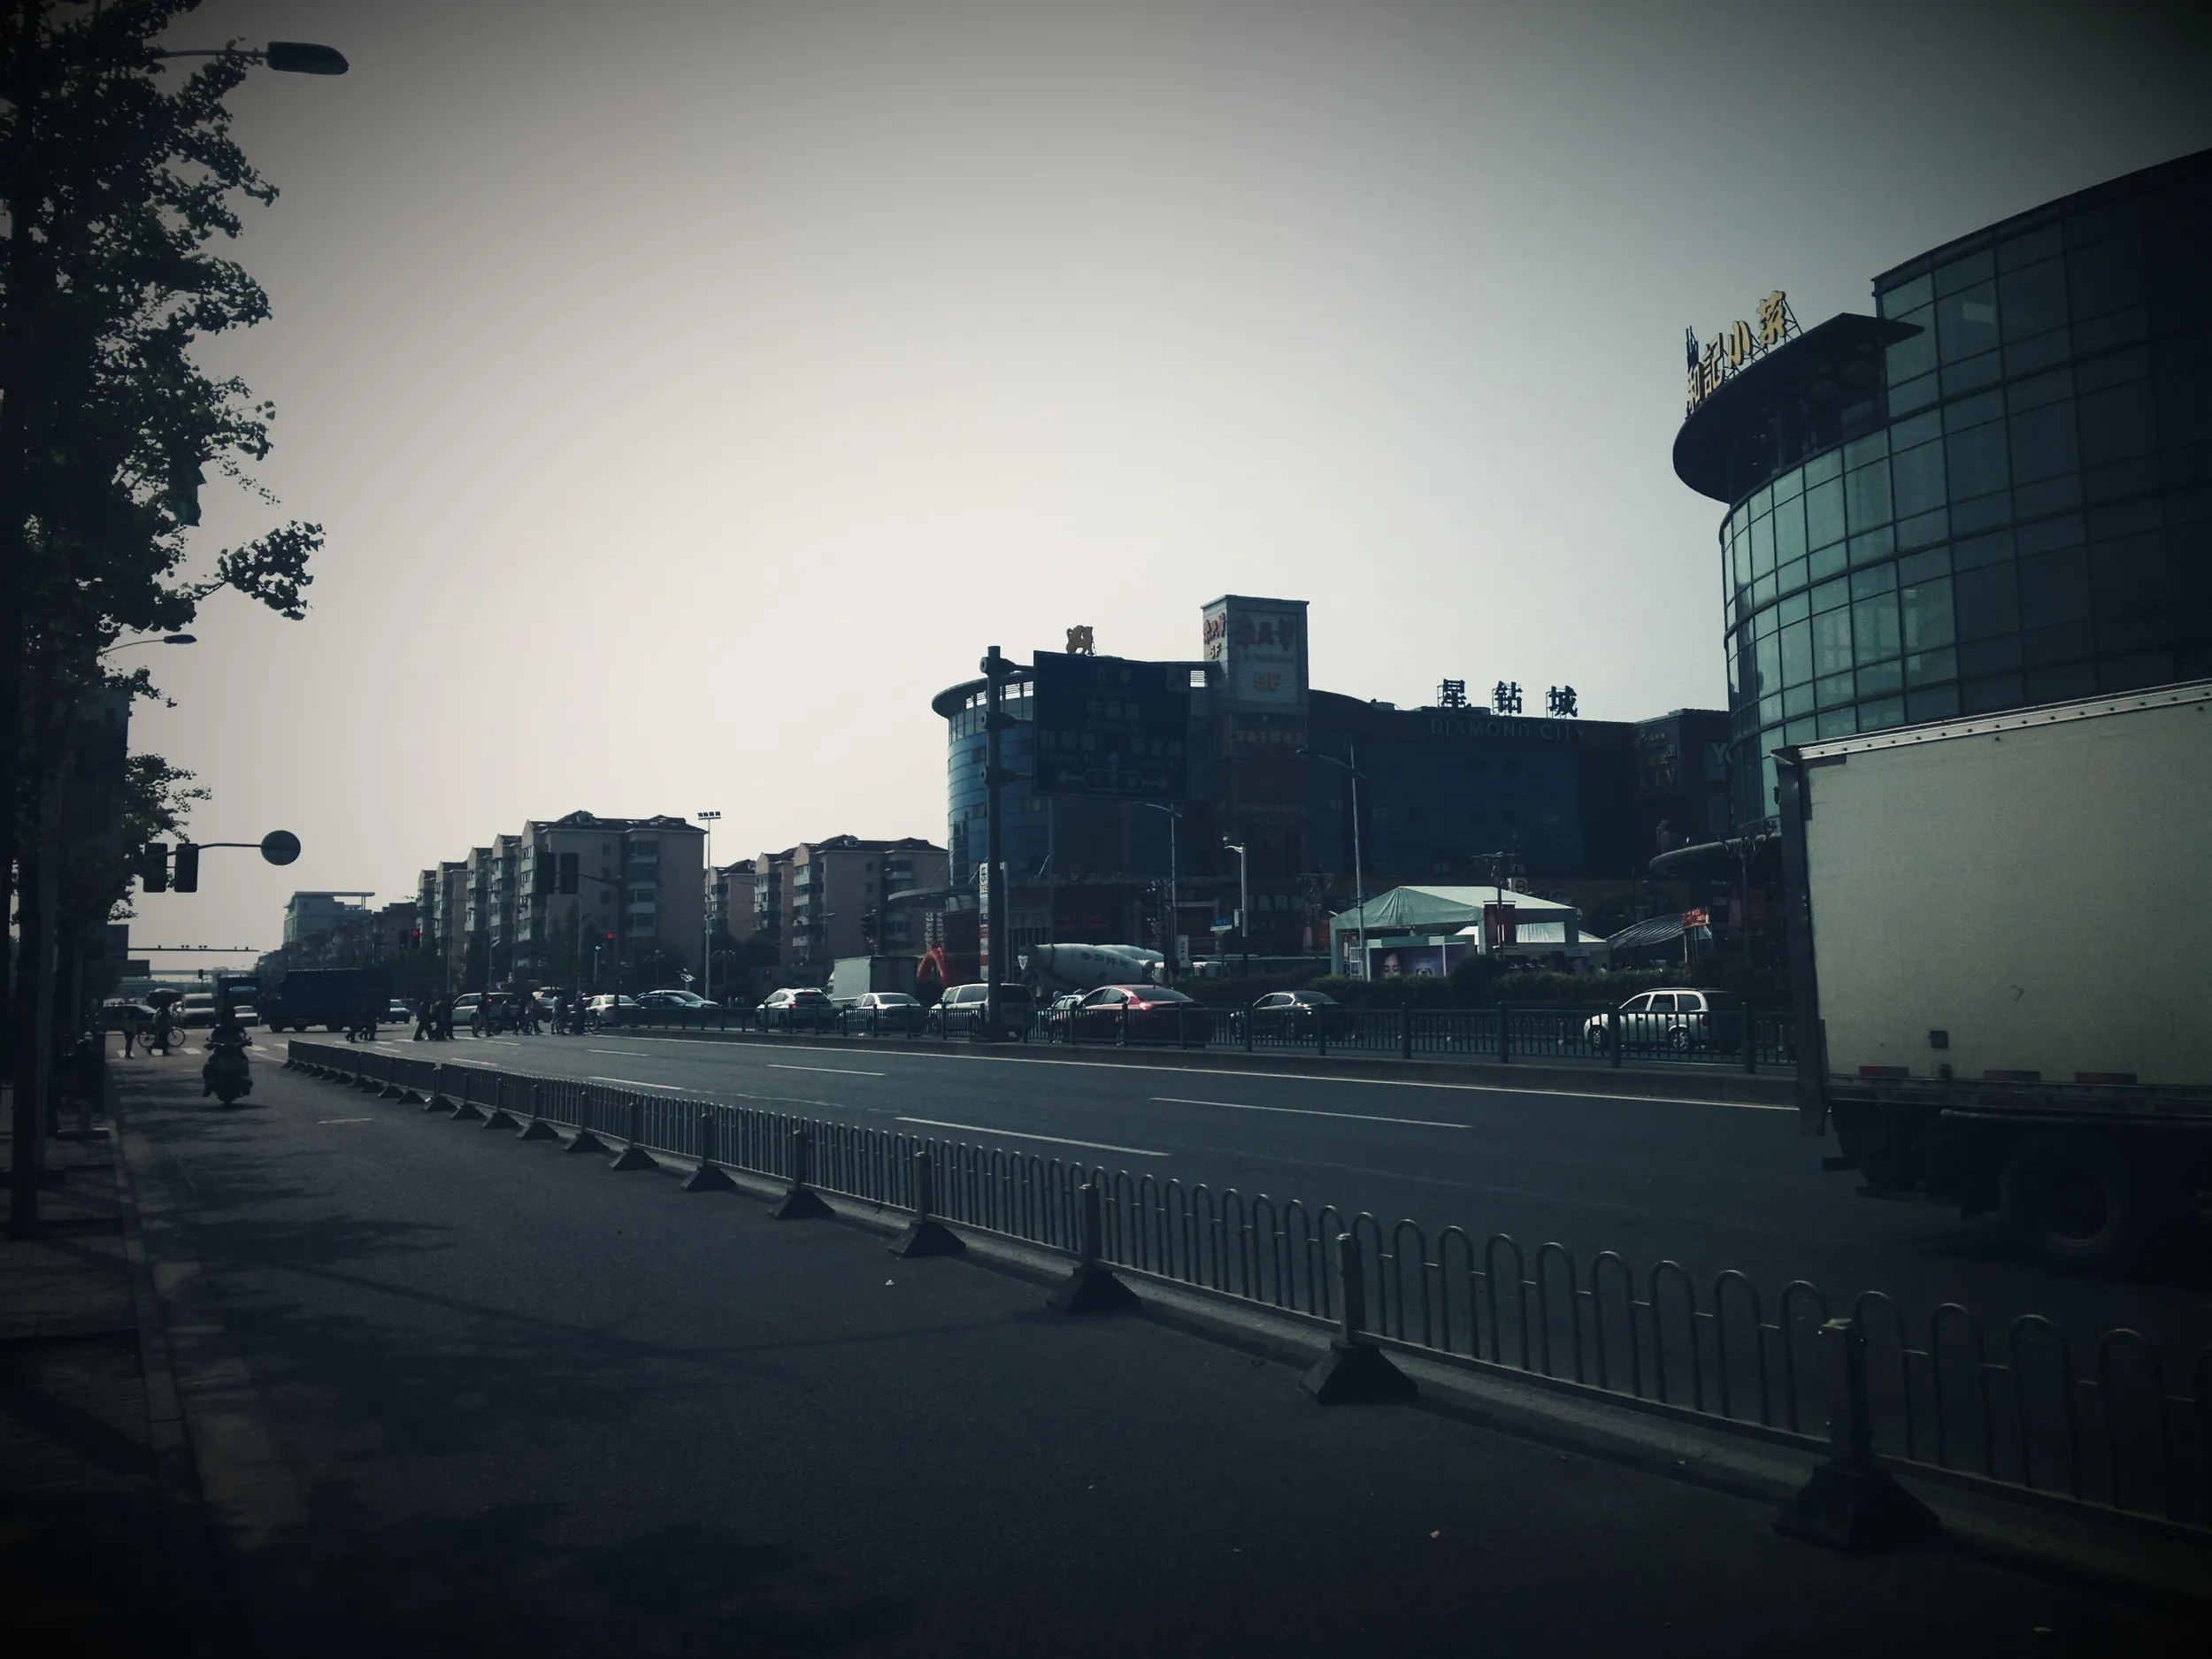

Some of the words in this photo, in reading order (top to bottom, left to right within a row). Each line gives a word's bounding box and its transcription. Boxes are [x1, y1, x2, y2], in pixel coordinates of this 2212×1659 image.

[1441, 679, 1578, 718] 星钻城
[1431, 718, 1531, 740] DIAMOND
[1540, 724, 1586, 741] CITY
